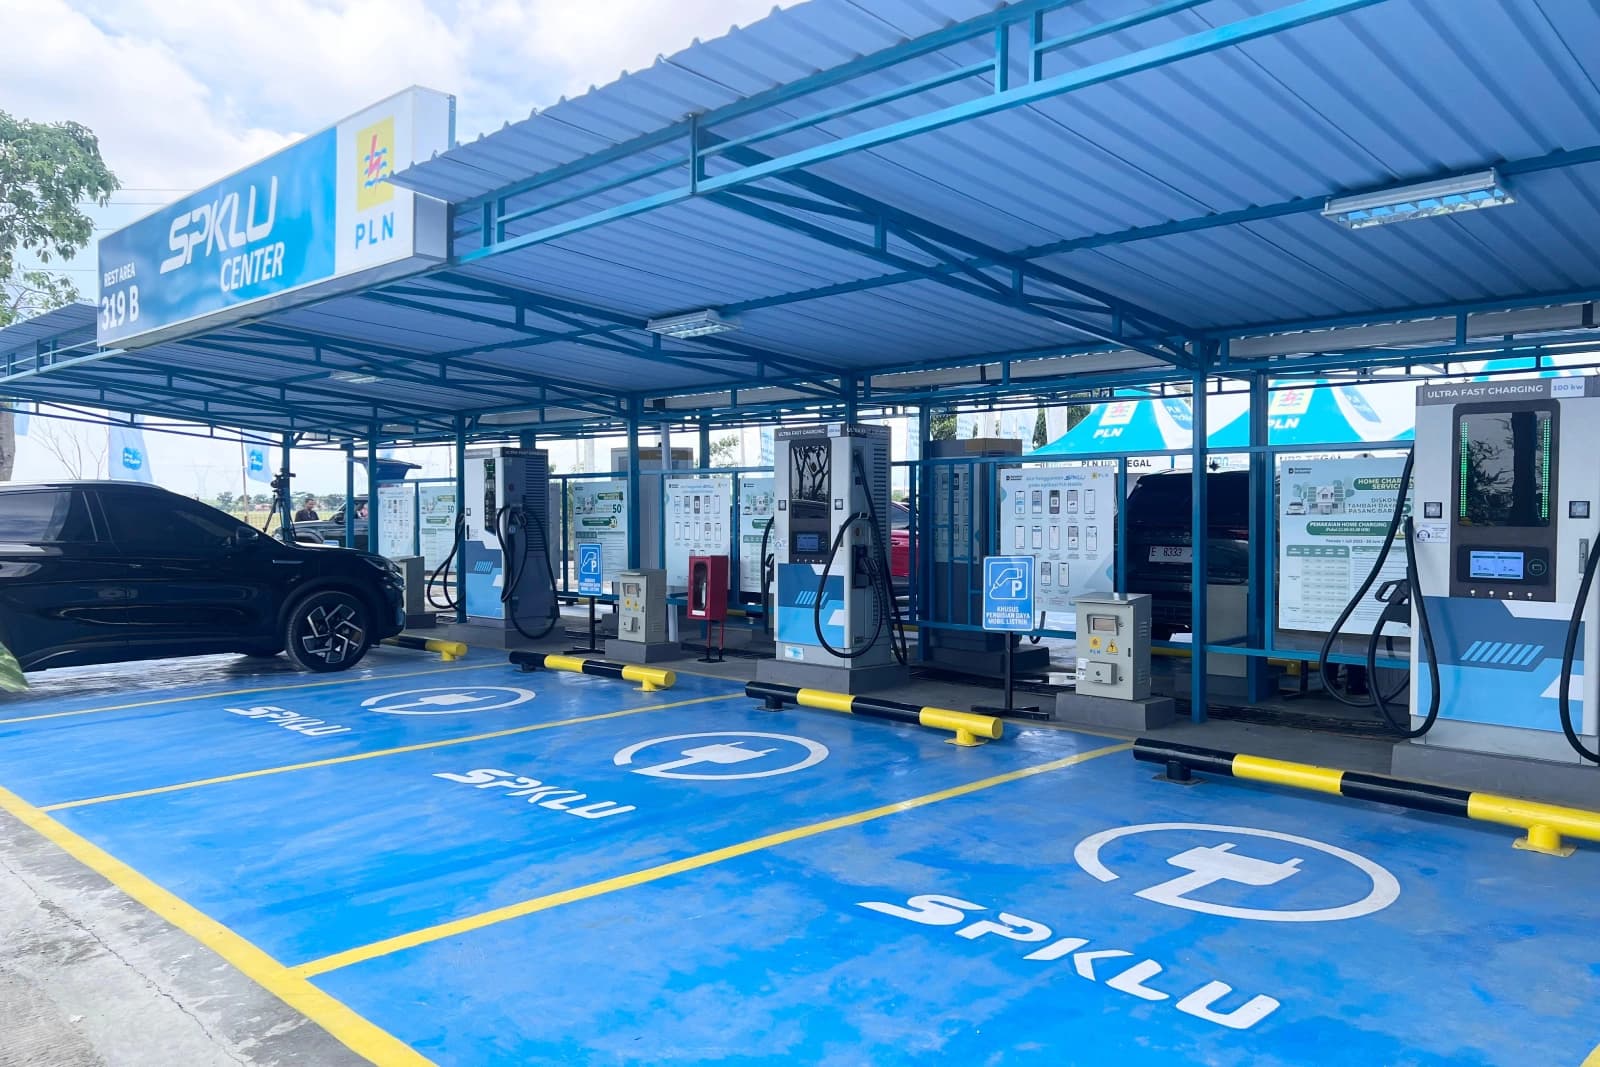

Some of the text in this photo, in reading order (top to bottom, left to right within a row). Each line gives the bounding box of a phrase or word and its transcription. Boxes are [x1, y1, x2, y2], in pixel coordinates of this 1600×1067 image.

[160, 176, 278, 274] SPKLU
[355, 212, 394, 249] PLN
[104, 261, 136, 288] REST AREA
[220, 241, 285, 293] CENTER
[101, 285, 140, 331] 319 B
[1427, 384, 1544, 398] ULTRA FAST CHARGING
[1553, 384, 1568, 392] 100
[1093, 428, 1123, 439] PLN
[1268, 417, 1300, 429] PLN
[1127, 458, 1152, 467] EGAL
[612, 503, 622, 514] 50
[1151, 547, 1157, 557] E
[224, 706, 352, 737] SPKLU
[433, 768, 637, 820] SPKLU
[855, 894, 1280, 1030] SPKLU
